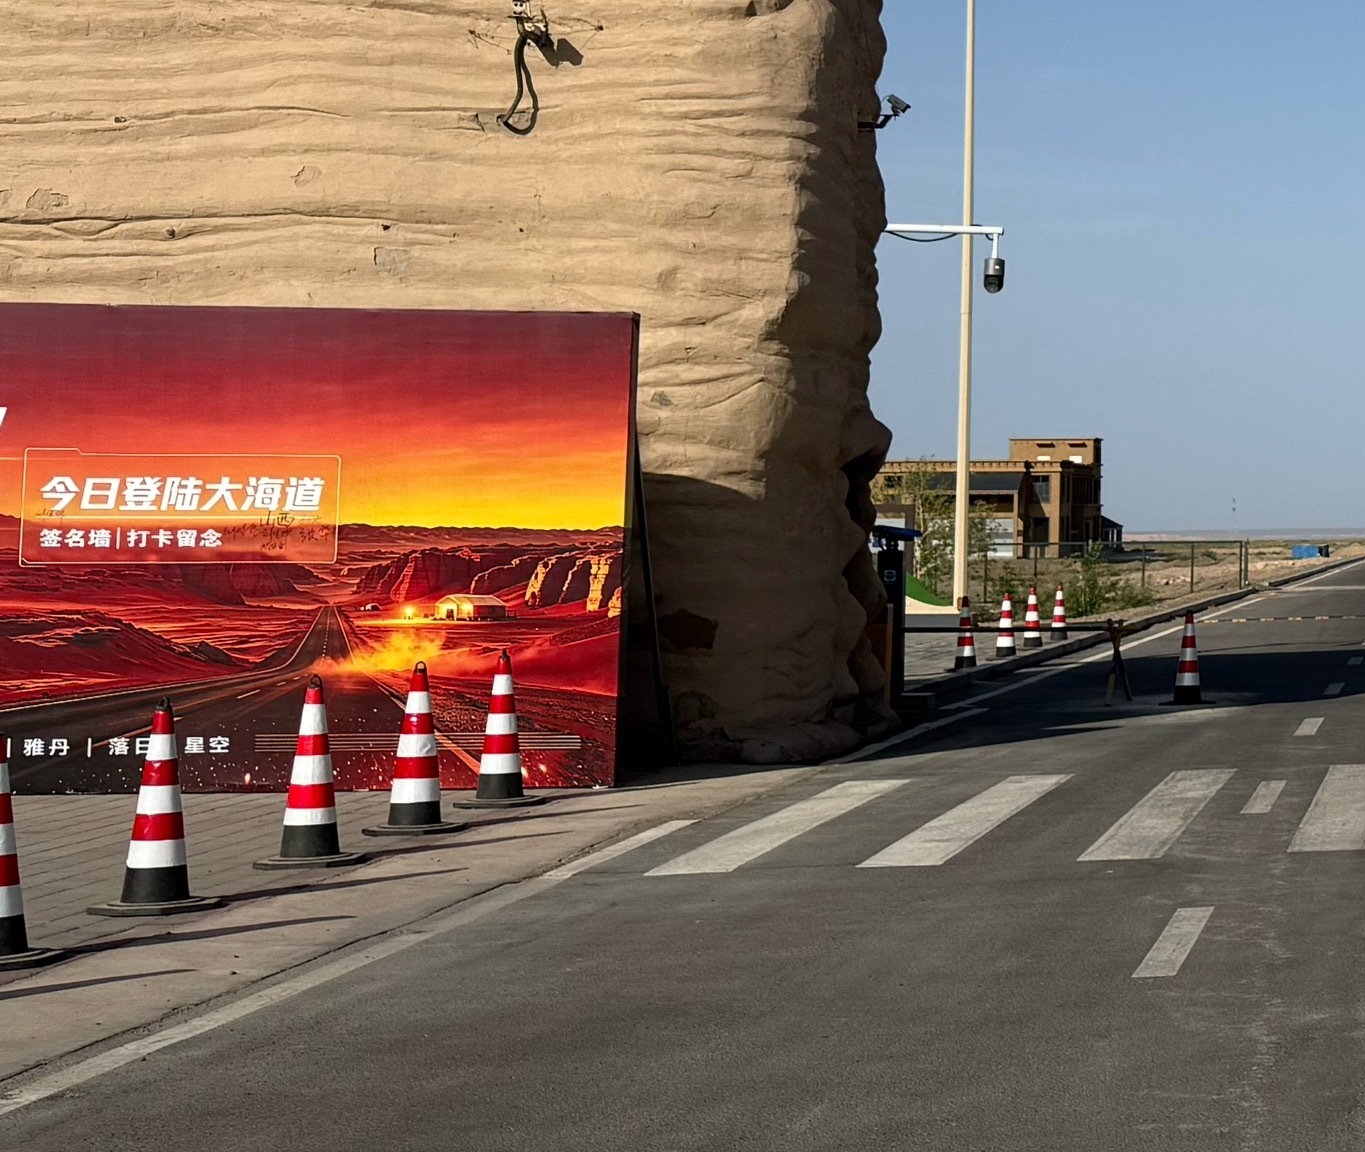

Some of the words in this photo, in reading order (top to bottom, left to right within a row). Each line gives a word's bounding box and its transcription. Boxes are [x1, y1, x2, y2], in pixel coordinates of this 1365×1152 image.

[39, 476, 325, 511] 今日登陆大海道
[23, 738, 70, 756] 雅丹
[184, 736, 230, 754] 星空
